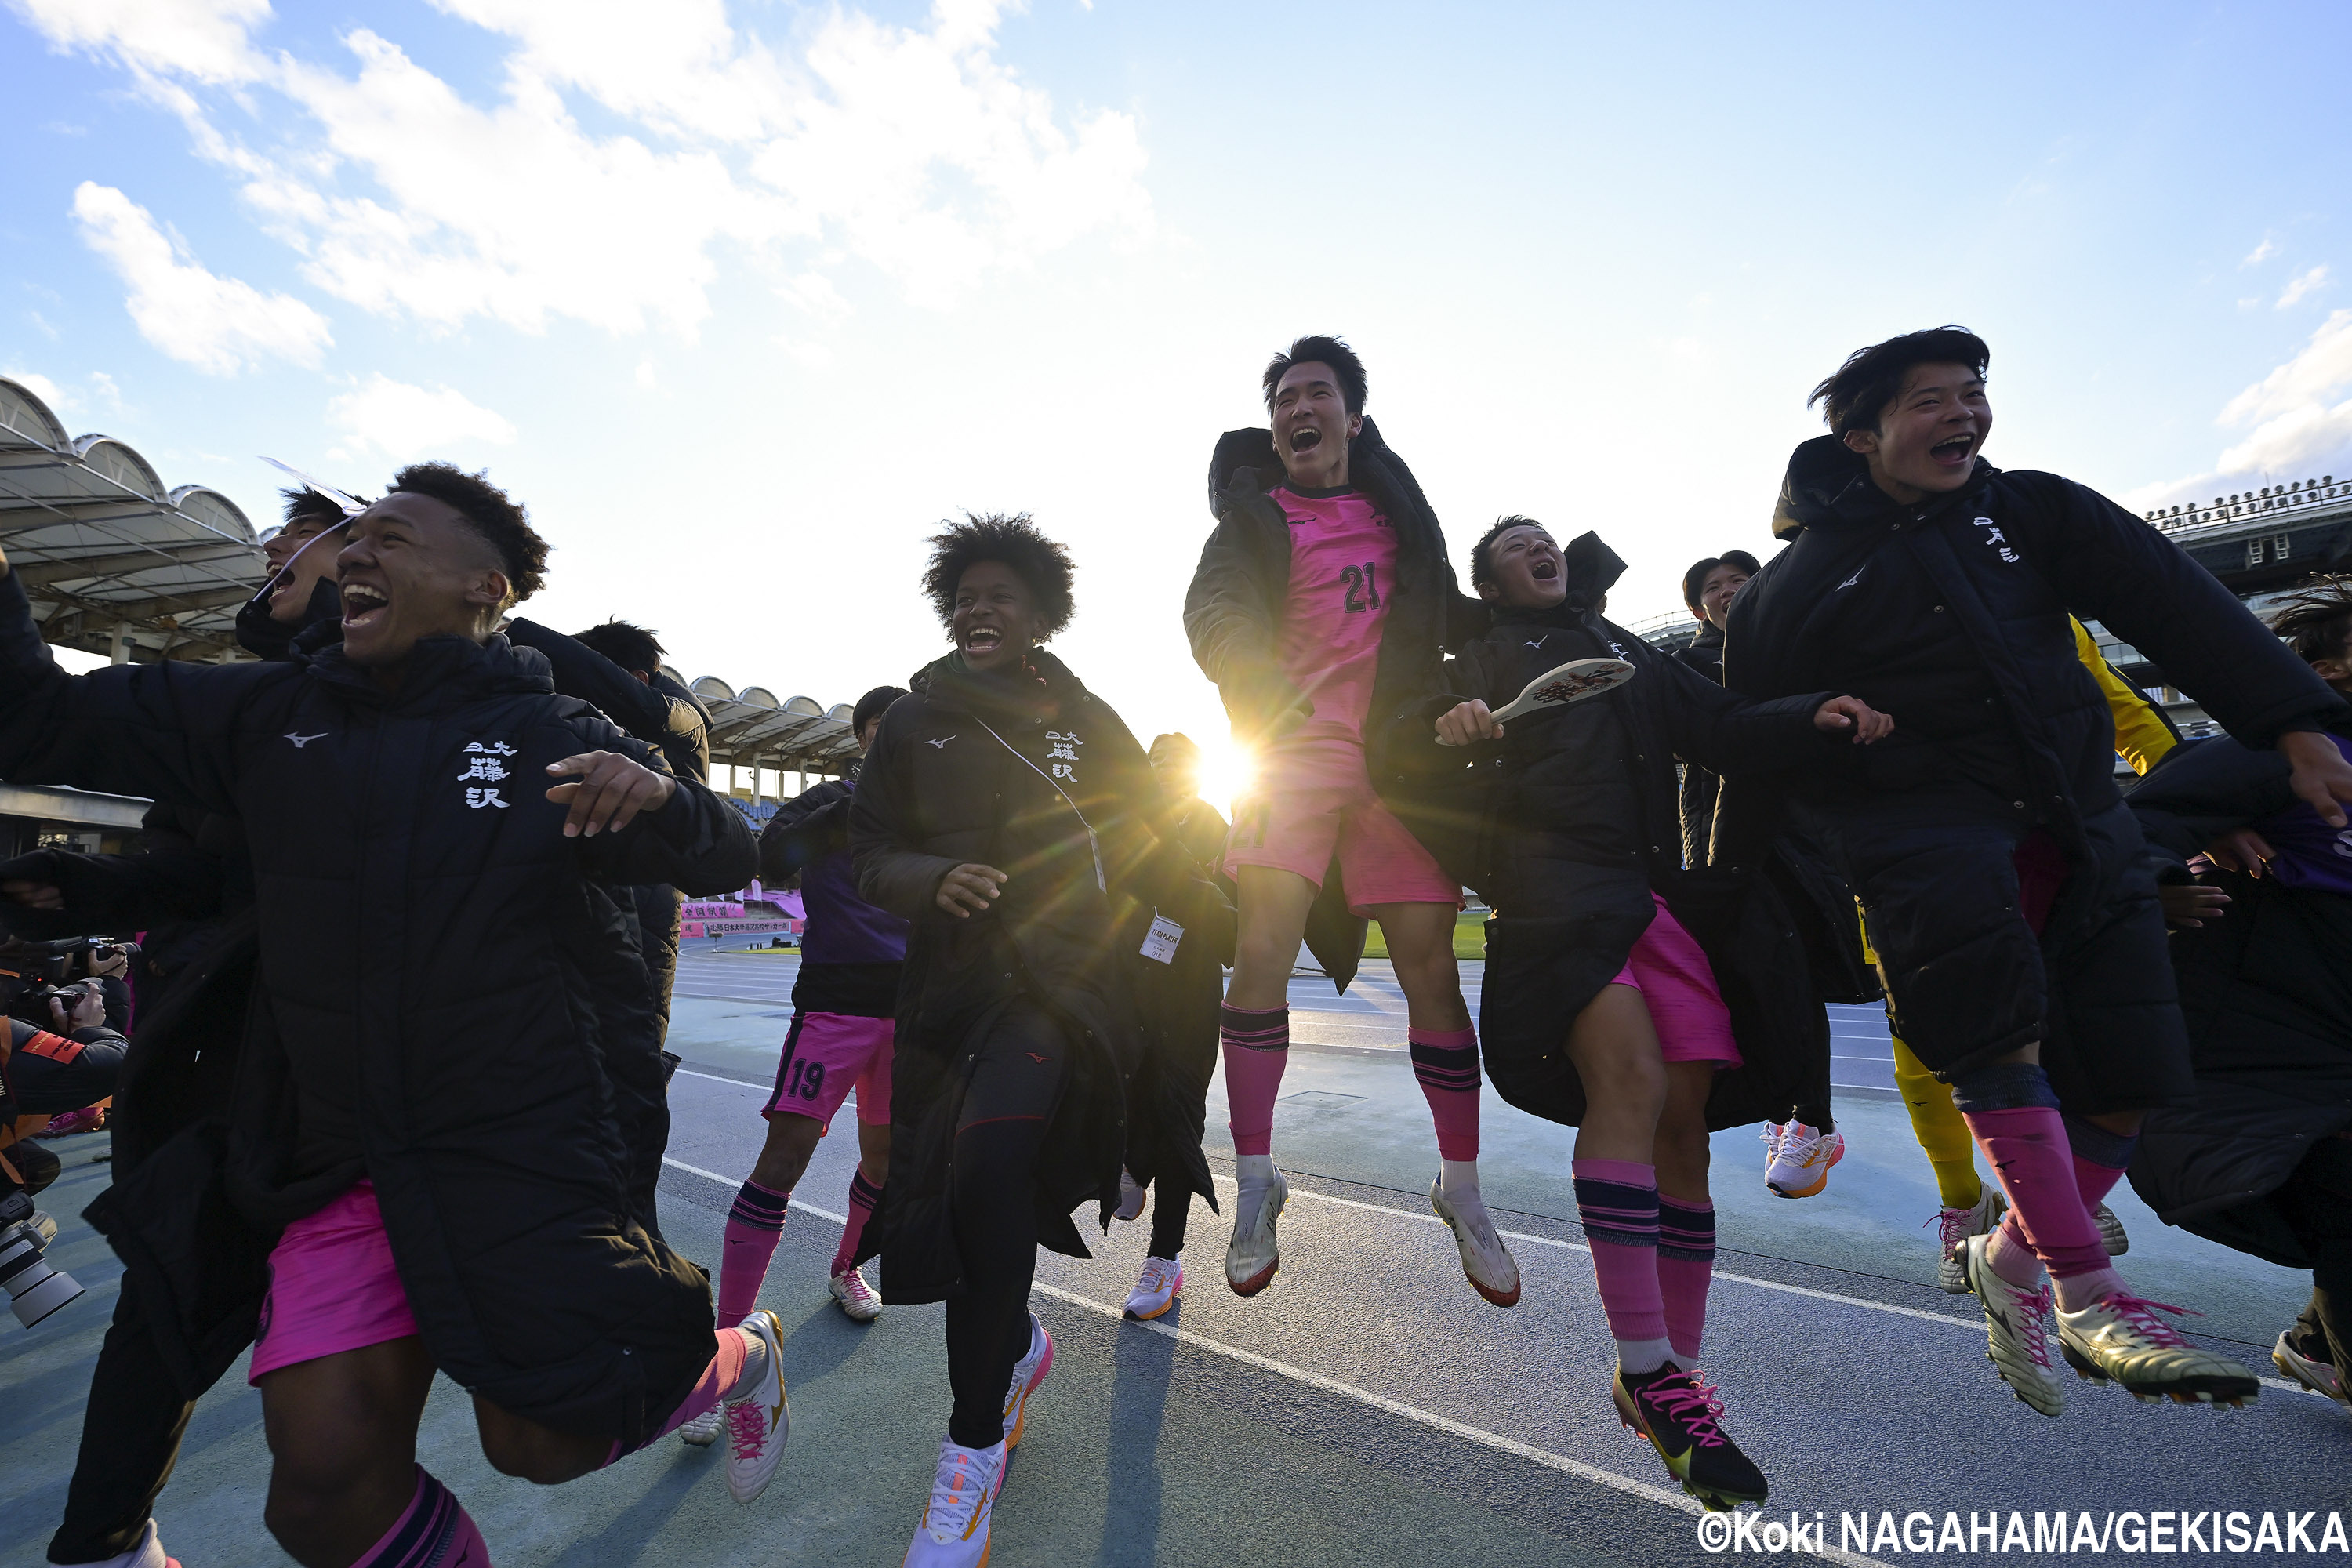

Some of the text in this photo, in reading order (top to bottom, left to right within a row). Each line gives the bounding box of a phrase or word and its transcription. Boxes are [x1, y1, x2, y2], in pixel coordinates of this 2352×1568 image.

[1340, 562, 1381, 613] 21
[1152, 929, 1163, 938] TEAM
[1162, 933, 1178, 944] PLAYER
[788, 1058, 826, 1101] 19
